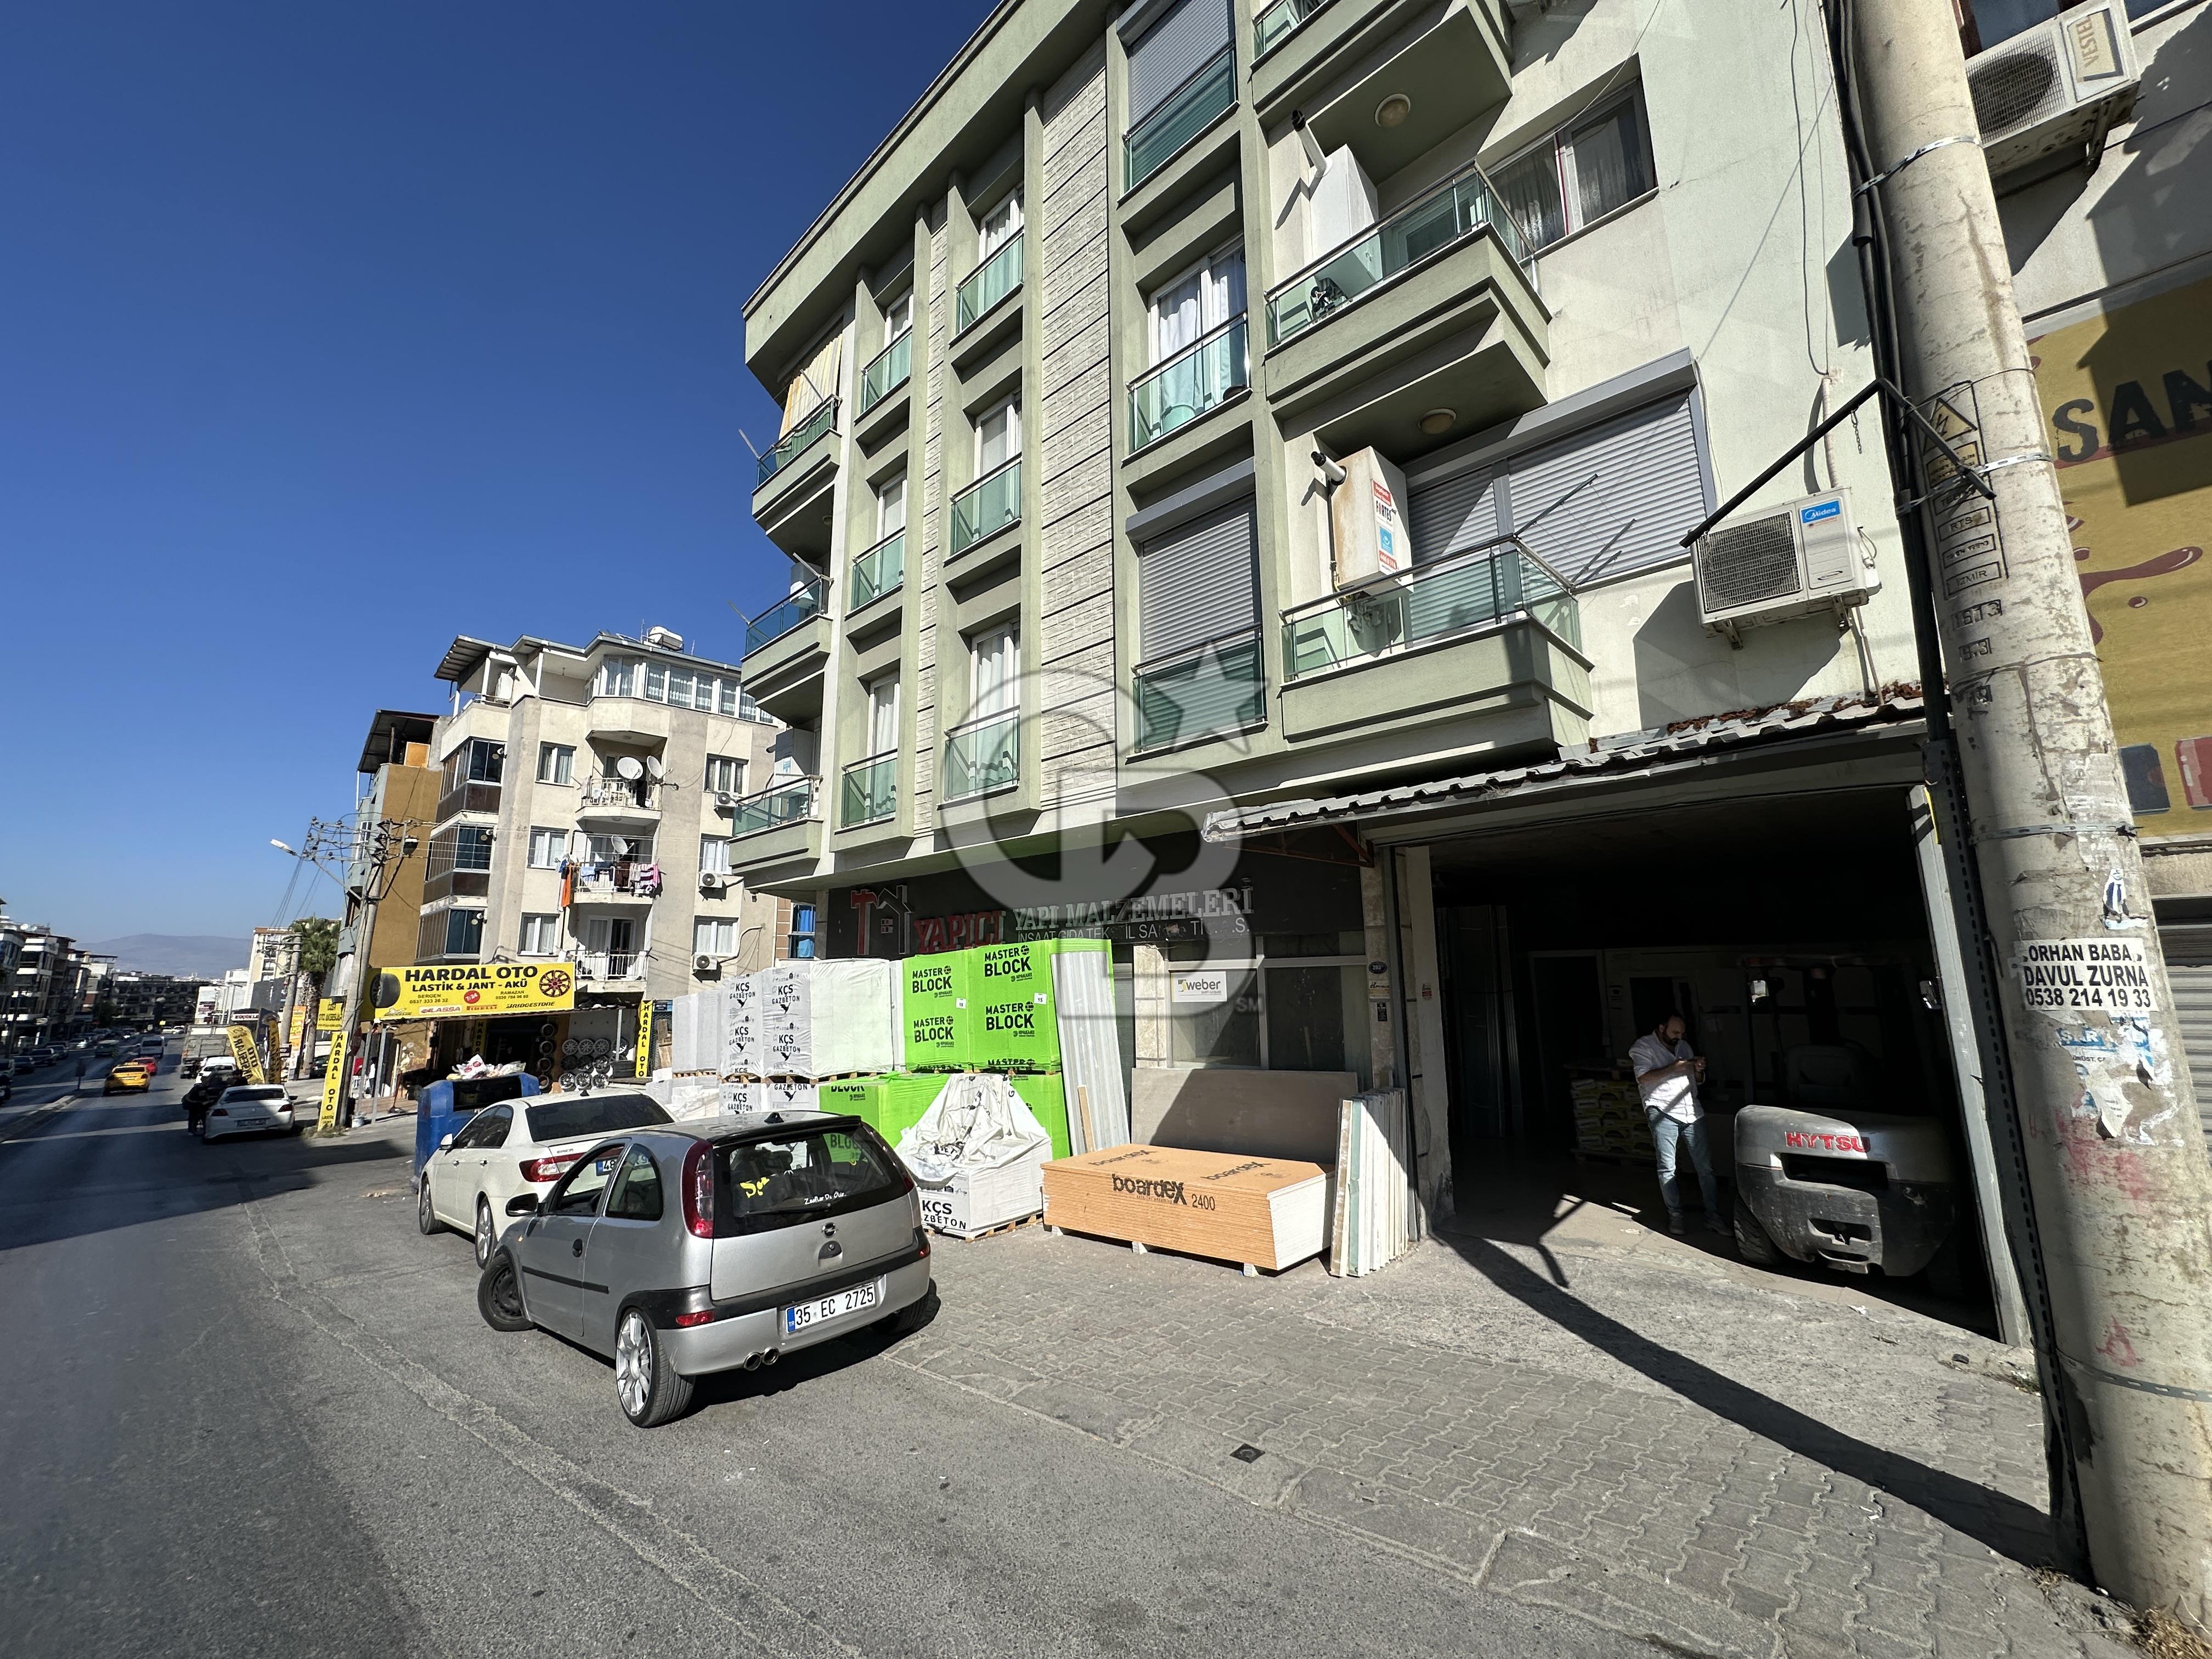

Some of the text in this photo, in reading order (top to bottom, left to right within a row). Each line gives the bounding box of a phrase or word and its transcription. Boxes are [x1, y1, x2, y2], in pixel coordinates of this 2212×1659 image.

[1809, 507, 1836, 518] Midea
[1013, 878, 1254, 930] YAPI MALZEMELERİ
[914, 911, 1006, 953] YAPICI
[985, 947, 1020, 961] MASTER
[2029, 944, 2132, 961] ORHAN BABA
[405, 966, 538, 981] HARDAL OTO
[912, 967, 943, 979] MASTER
[984, 956, 1032, 977] BLOCK
[2024, 965, 2149, 986] DAVUL ZURNA
[413, 981, 454, 992] LASTİK
[466, 981, 494, 990] JANT
[505, 978, 528, 988] AKÜ
[736, 982, 750, 994] KÇS
[778, 985, 793, 996] KÇS
[912, 976, 952, 993] BLOCK
[1186, 979, 1221, 990] weber
[772, 995, 800, 1005] GAZBETON
[2025, 988, 2151, 1007] 0538 214 19 33
[986, 1003, 1024, 1015] MASTER
[641, 1005, 650, 1047] HARDAL
[913, 1017, 945, 1029] MASTER
[986, 1014, 1034, 1031] BLOCK
[735, 1026, 749, 1038] KÇS
[914, 1026, 954, 1043] BLOCK
[729, 1036, 755, 1045] GAZBETON
[778, 1035, 794, 1046] KÇS
[326, 1034, 343, 1111] HARDAL OTO
[733, 1093, 747, 1104] KÇS
[1785, 1131, 1871, 1152] HYTSU
[1087, 1150, 1158, 1165] boardex
[1200, 1161, 1272, 1180] boardex
[1111, 1173, 1187, 1205] boardex
[922, 1200, 952, 1217] KÇS
[1192, 1193, 1216, 1211] 2400
[924, 1214, 966, 1229] ZBETON
[795, 1306, 810, 1326] 35
[821, 1299, 836, 1317] EC
[845, 1286, 873, 1311] 2725
